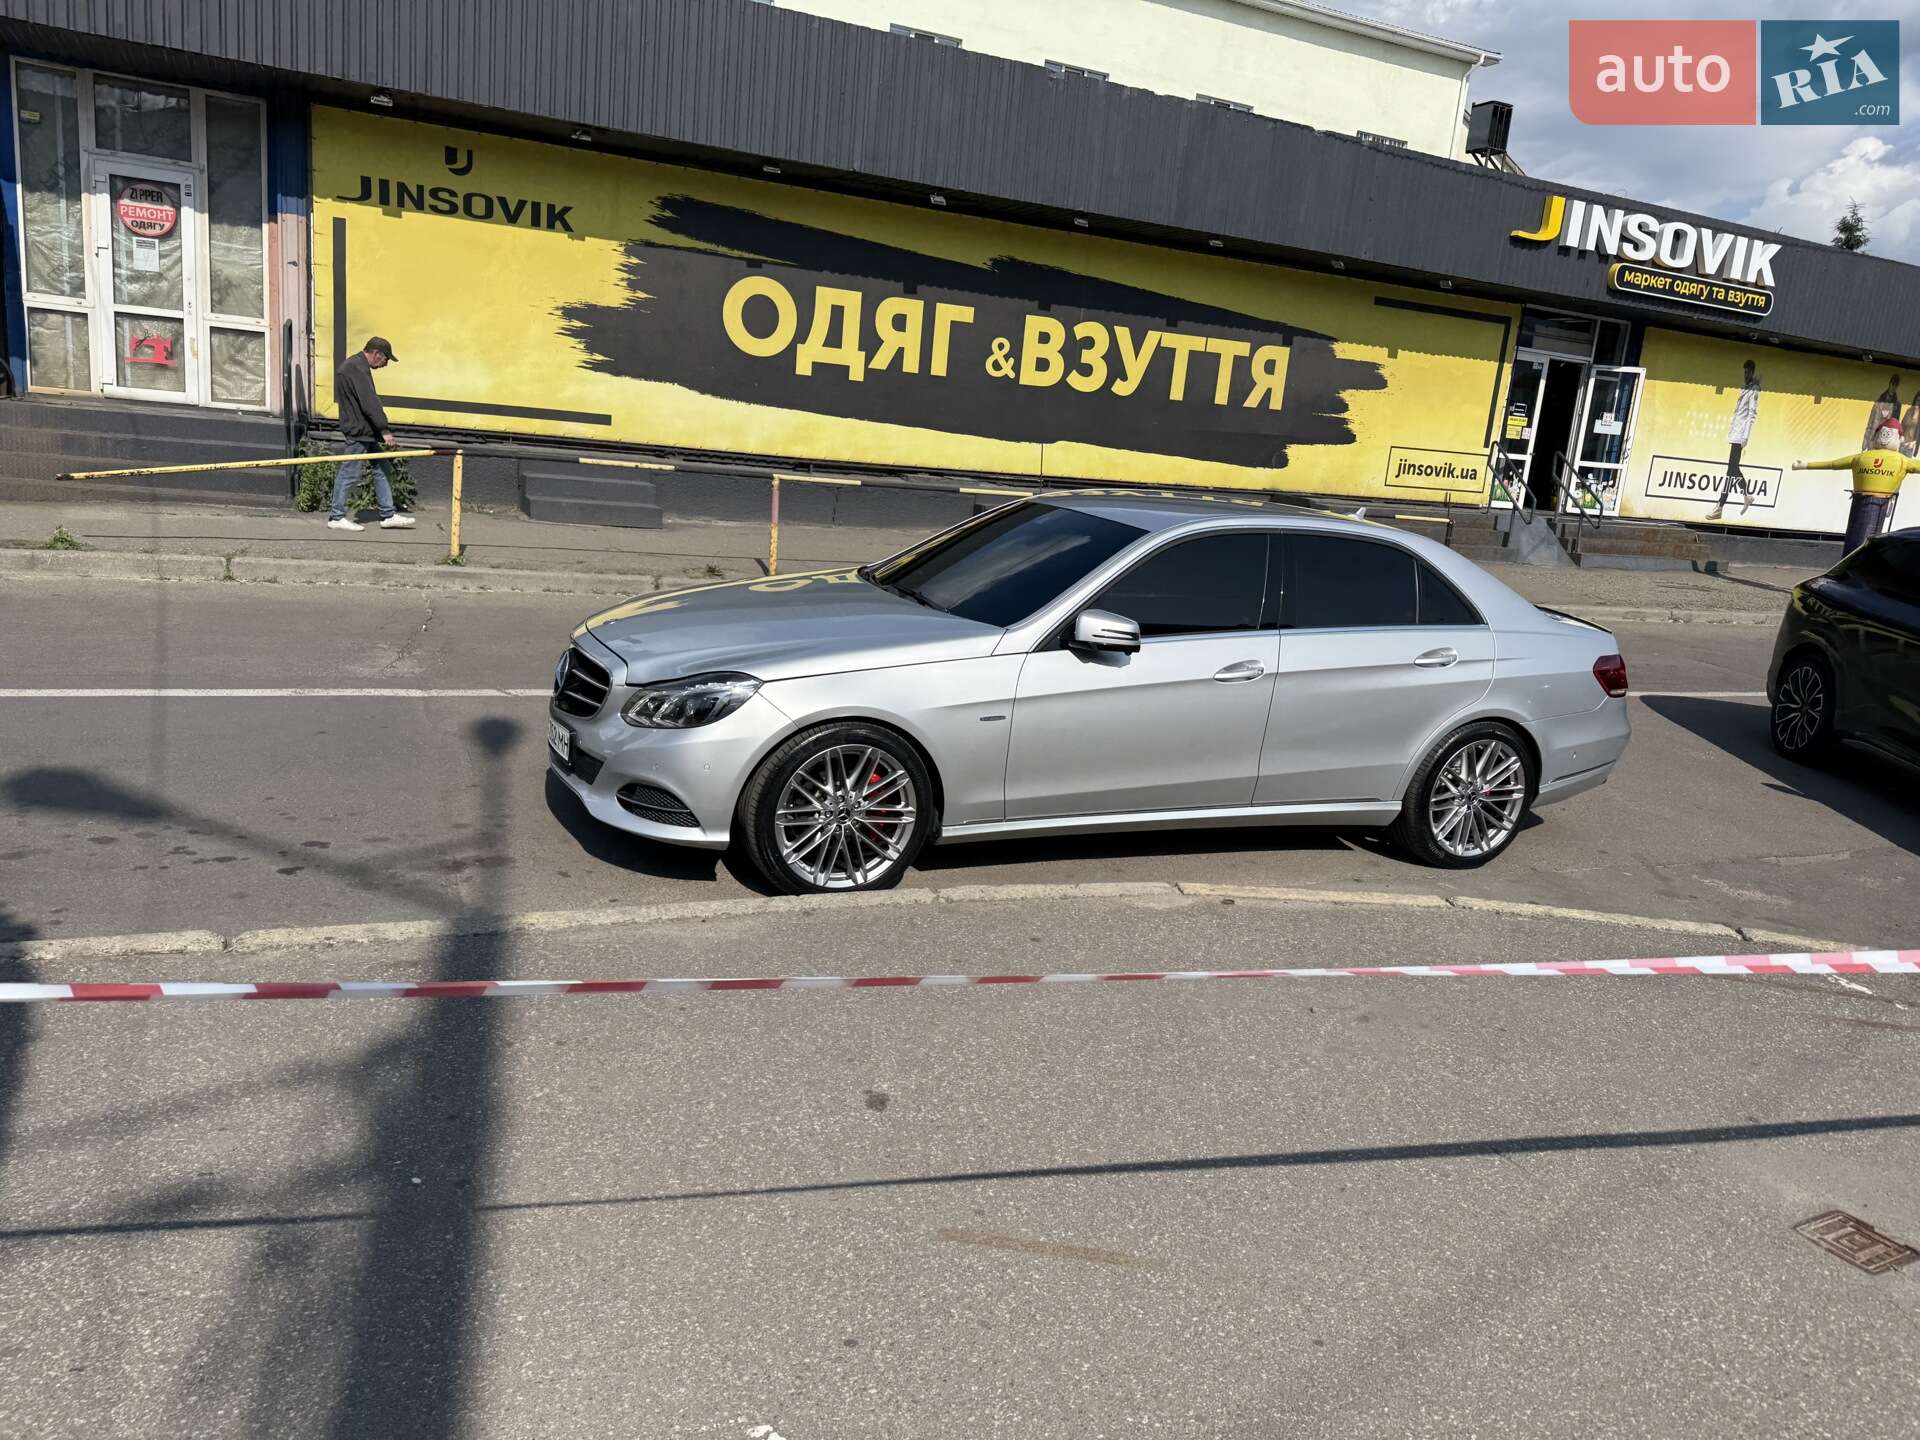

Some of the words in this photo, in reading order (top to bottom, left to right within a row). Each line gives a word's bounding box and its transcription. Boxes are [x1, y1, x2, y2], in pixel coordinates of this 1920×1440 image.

[129, 187, 164, 203] ZIPPER
[336, 175, 575, 233] JINSOVIK
[120, 205, 174, 220] РЕМОНТ
[131, 220, 165, 231] ОДЯГУ
[1509, 195, 1783, 287] JINSOVIK
[1623, 270, 1672, 290] маркет
[1673, 279, 1710, 299] одягу
[1712, 286, 1724, 300] та
[1727, 289, 1766, 307] взуття
[722, 275, 975, 382] ОДЯГ
[985, 337, 1016, 379] &
[1018, 314, 1291, 411] ВЗУТТЯ
[1395, 458, 1478, 480] jinsovik.ua
[1857, 467, 1896, 477] JINSOVIK
[1658, 470, 1768, 497] JINSOVIK.UA
